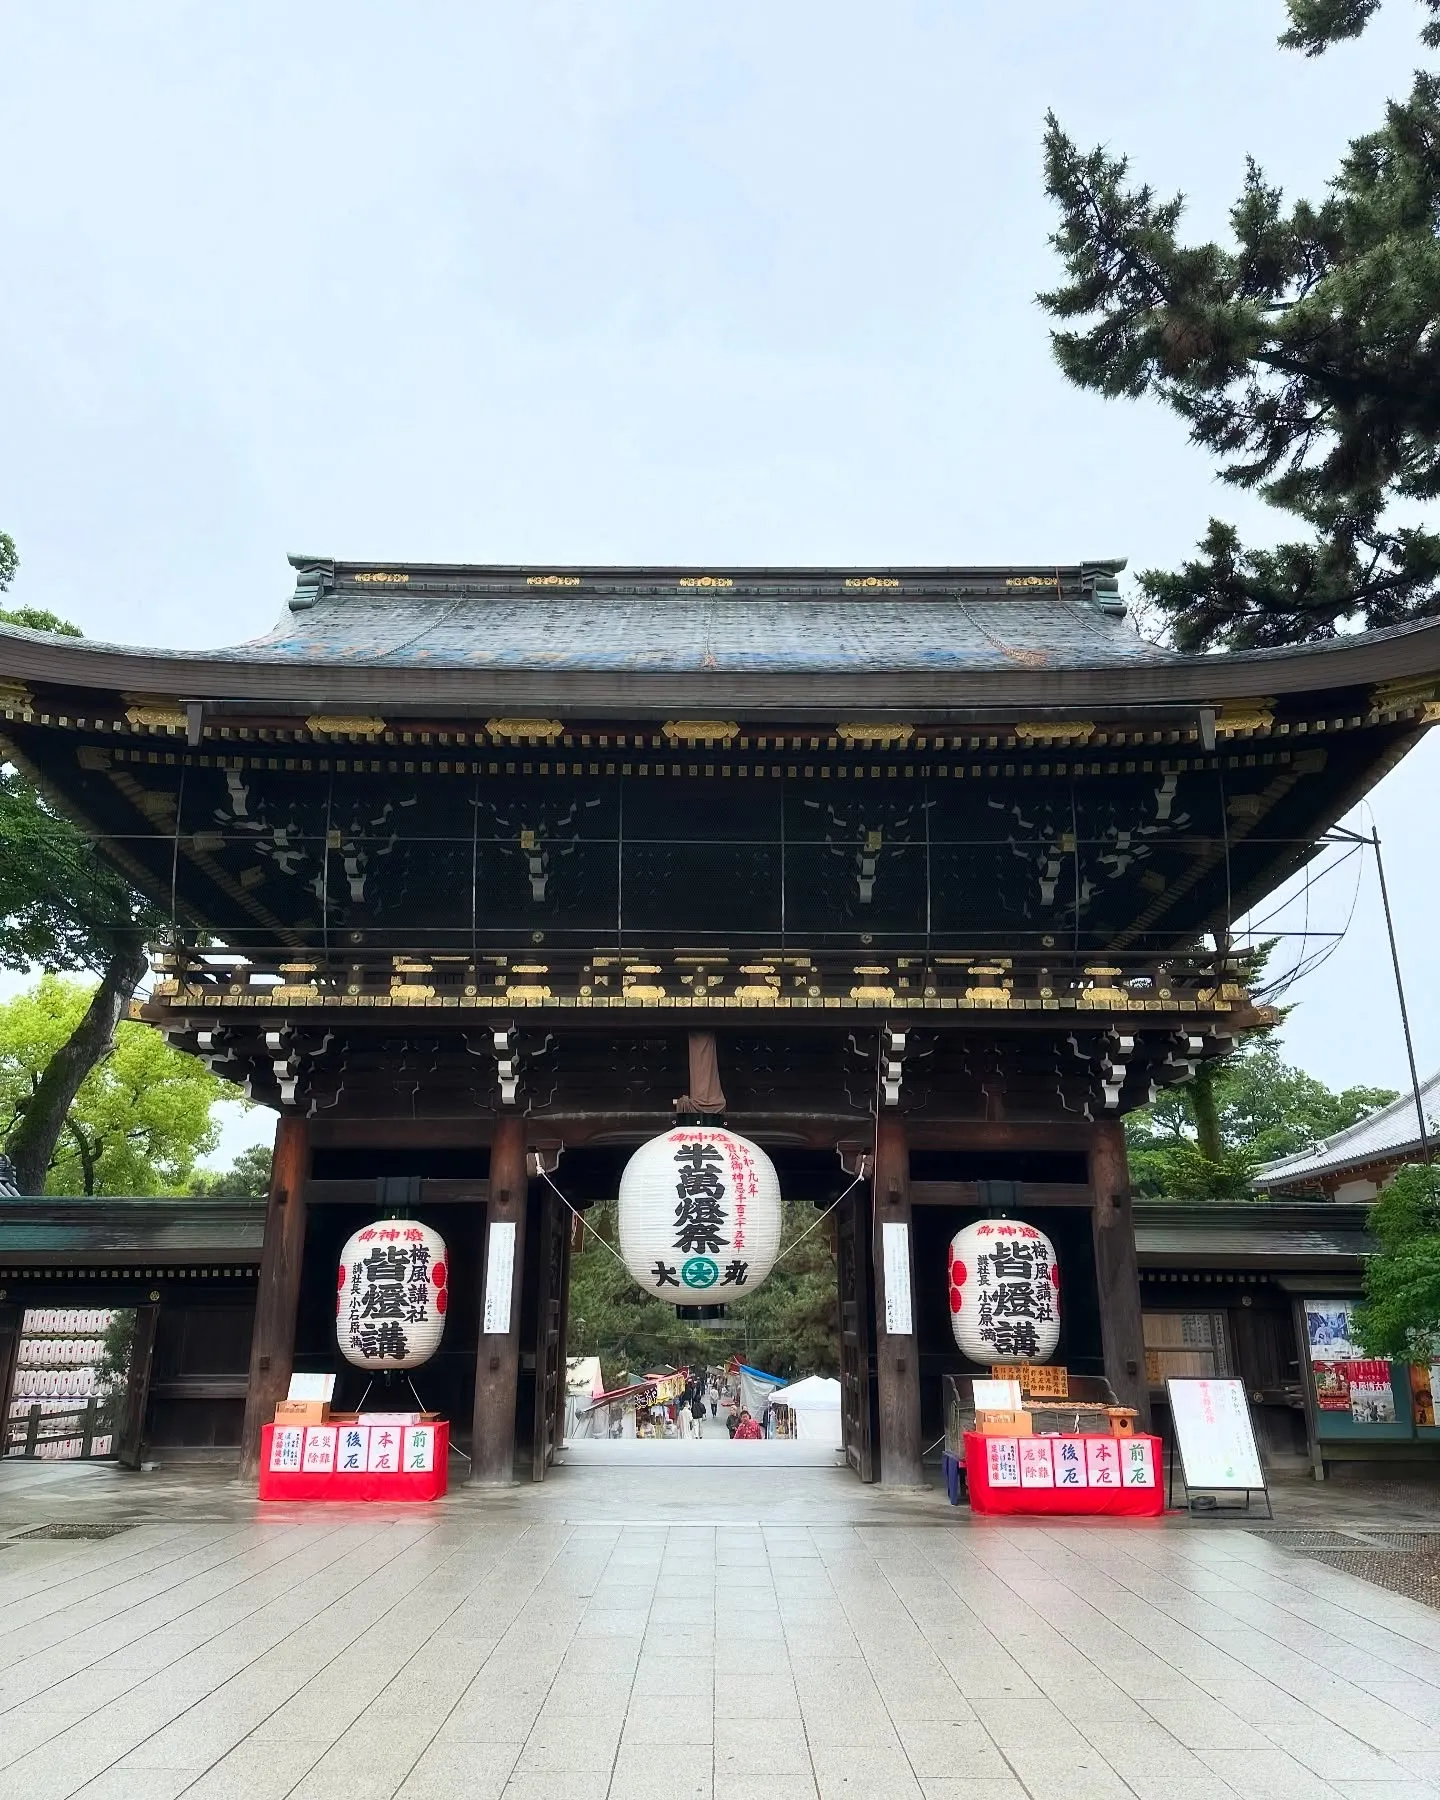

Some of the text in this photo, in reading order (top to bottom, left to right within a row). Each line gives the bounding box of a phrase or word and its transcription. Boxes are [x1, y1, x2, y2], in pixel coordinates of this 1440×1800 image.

[739, 1144, 759, 1197] 令和九年
[672, 1143, 731, 1254] 半萬燈祭
[358, 1228, 424, 1242] 御神燈
[403, 1243, 431, 1324] 梅風講社
[651, 1261, 680, 1287] 大
[720, 1260, 749, 1286] 丸
[1031, 1240, 1054, 1323] 梅風講社
[360, 1246, 410, 1360] 皆燈講
[989, 1241, 1040, 1357] 皆燈講
[344, 1431, 362, 1469] 後厄
[375, 1432, 393, 1469] 本厄
[410, 1430, 428, 1469] 前厄
[1062, 1443, 1079, 1484] 後厄
[1095, 1444, 1112, 1484] 本厄
[1129, 1443, 1147, 1484] 前厄
